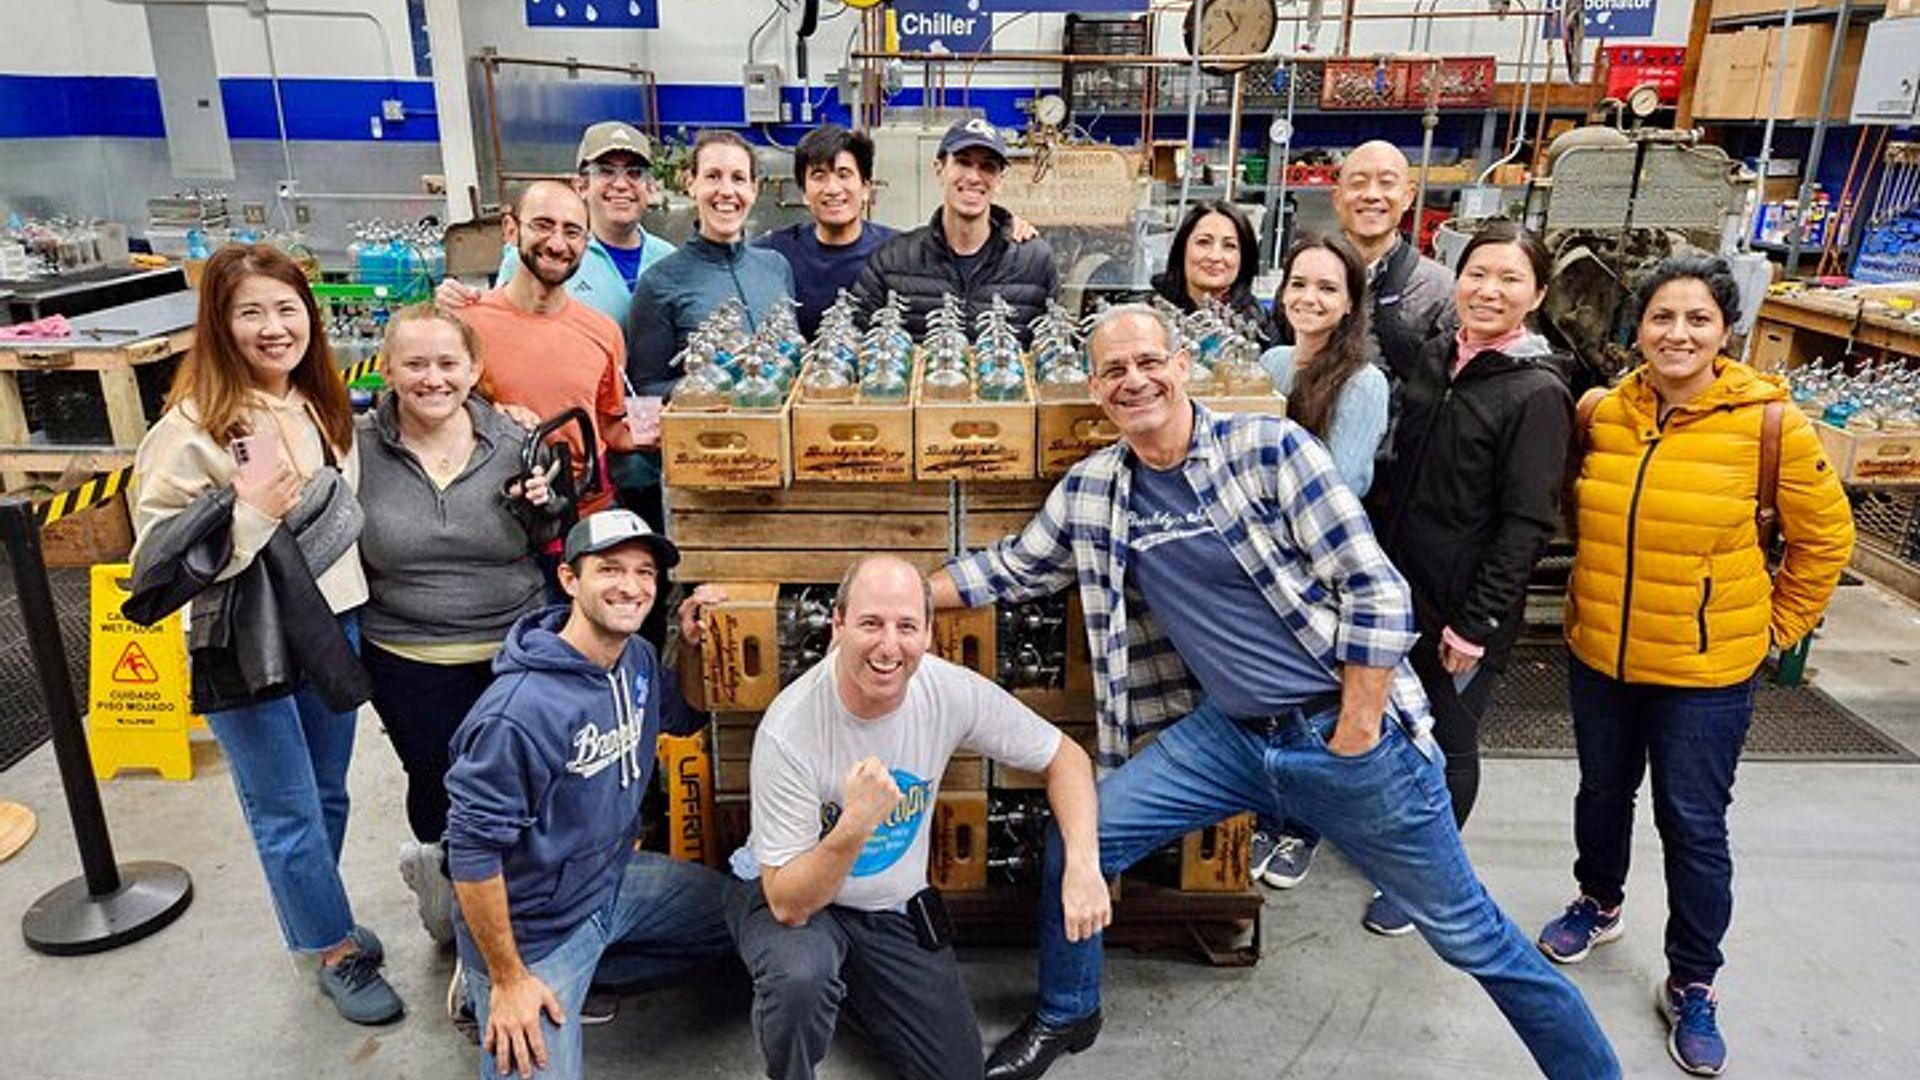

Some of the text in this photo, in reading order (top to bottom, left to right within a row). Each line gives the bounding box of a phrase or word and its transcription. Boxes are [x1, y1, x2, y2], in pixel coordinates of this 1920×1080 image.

[901, 12, 976, 35] Chiller
[101, 623, 123, 633] WET
[109, 689, 161, 701] CUIDADO
[96, 701, 175, 712] PISO MOJADO
